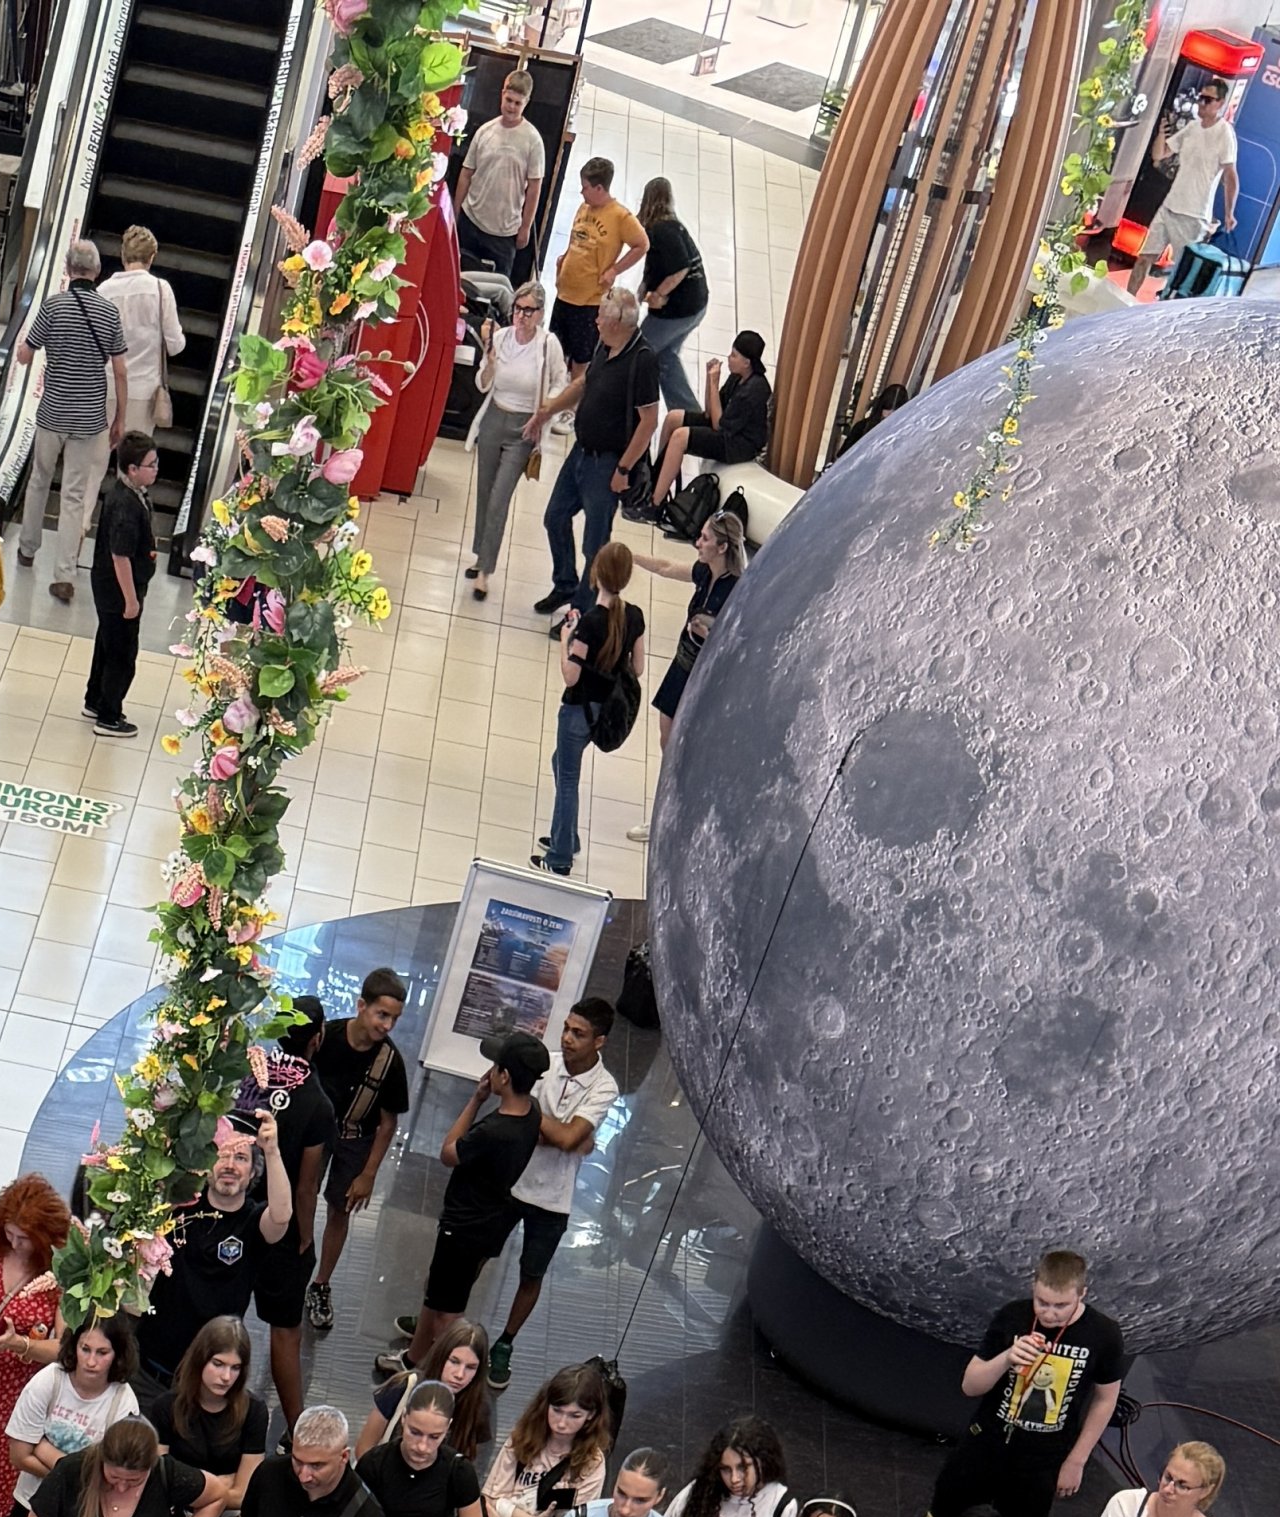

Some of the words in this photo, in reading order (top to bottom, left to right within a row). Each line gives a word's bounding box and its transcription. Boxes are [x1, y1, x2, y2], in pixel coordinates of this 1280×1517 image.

[80, 157, 95, 189] Nová
[88, 115, 105, 153] BENU
[101, 50, 120, 101] Lekáreň
[3, 809, 89, 835] 150M
